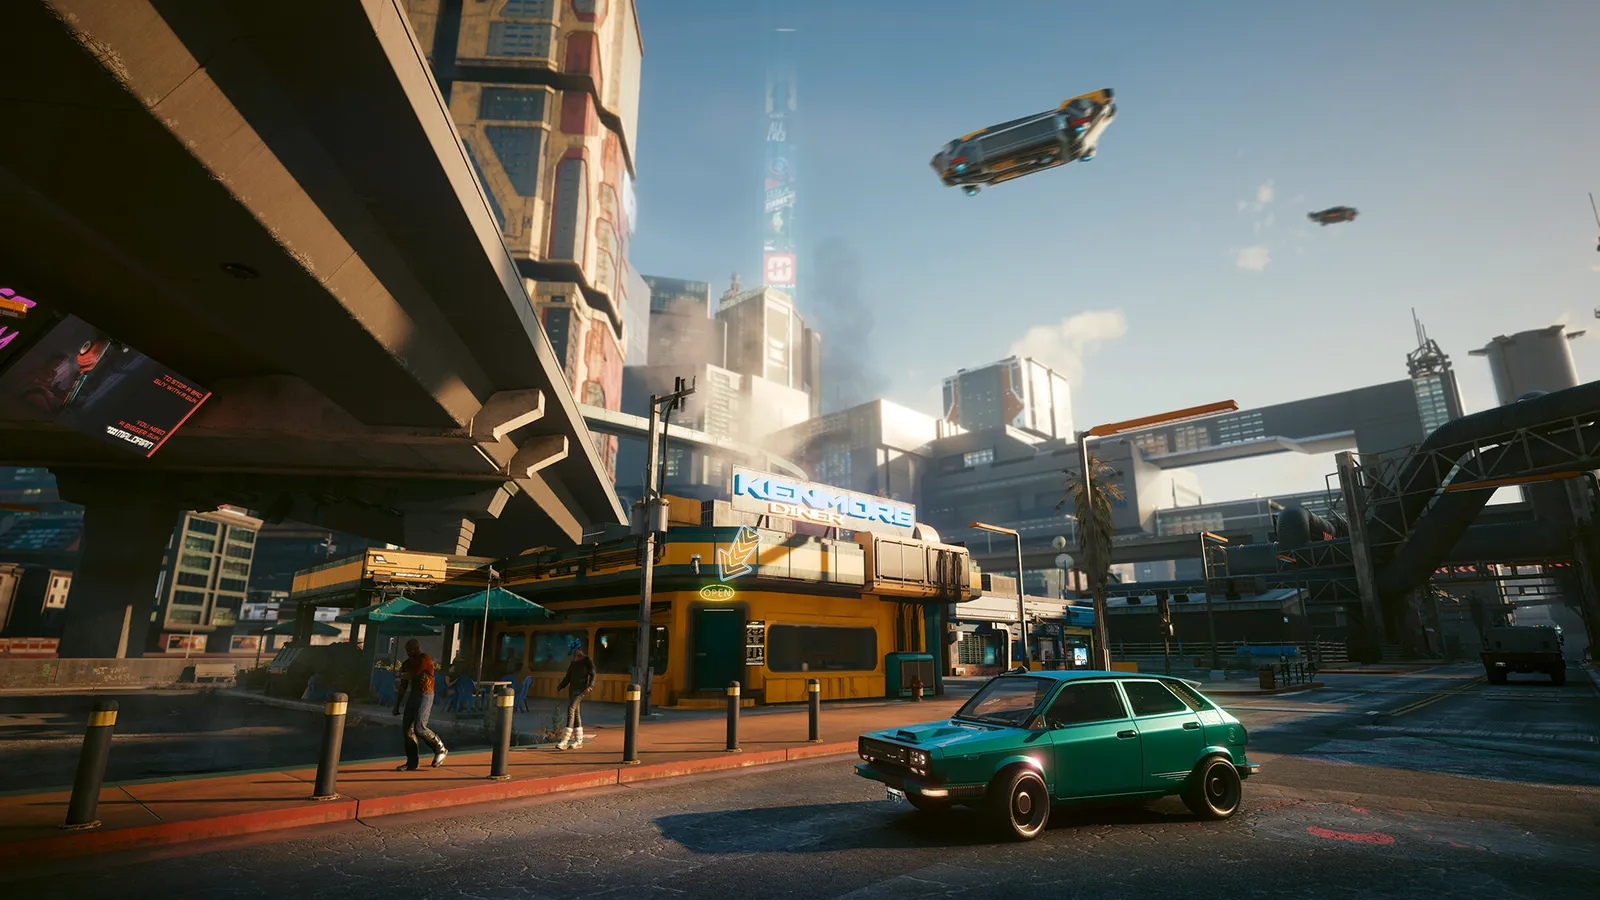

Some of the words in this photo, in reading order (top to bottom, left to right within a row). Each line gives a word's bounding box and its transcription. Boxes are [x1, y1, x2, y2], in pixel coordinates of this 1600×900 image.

[153, 378, 166, 388] GUY
[166, 385, 181, 396] WITH
[164, 374, 172, 382] TO
[171, 379, 187, 389] STOP
[190, 390, 203, 399] BAD
[124, 423, 148, 435] BIGGER
[137, 420, 150, 429] YOU
[149, 426, 166, 436] NEED
[734, 473, 914, 528] KENMORE
[768, 503, 845, 526] DINER
[704, 588, 731, 597] OPEN
